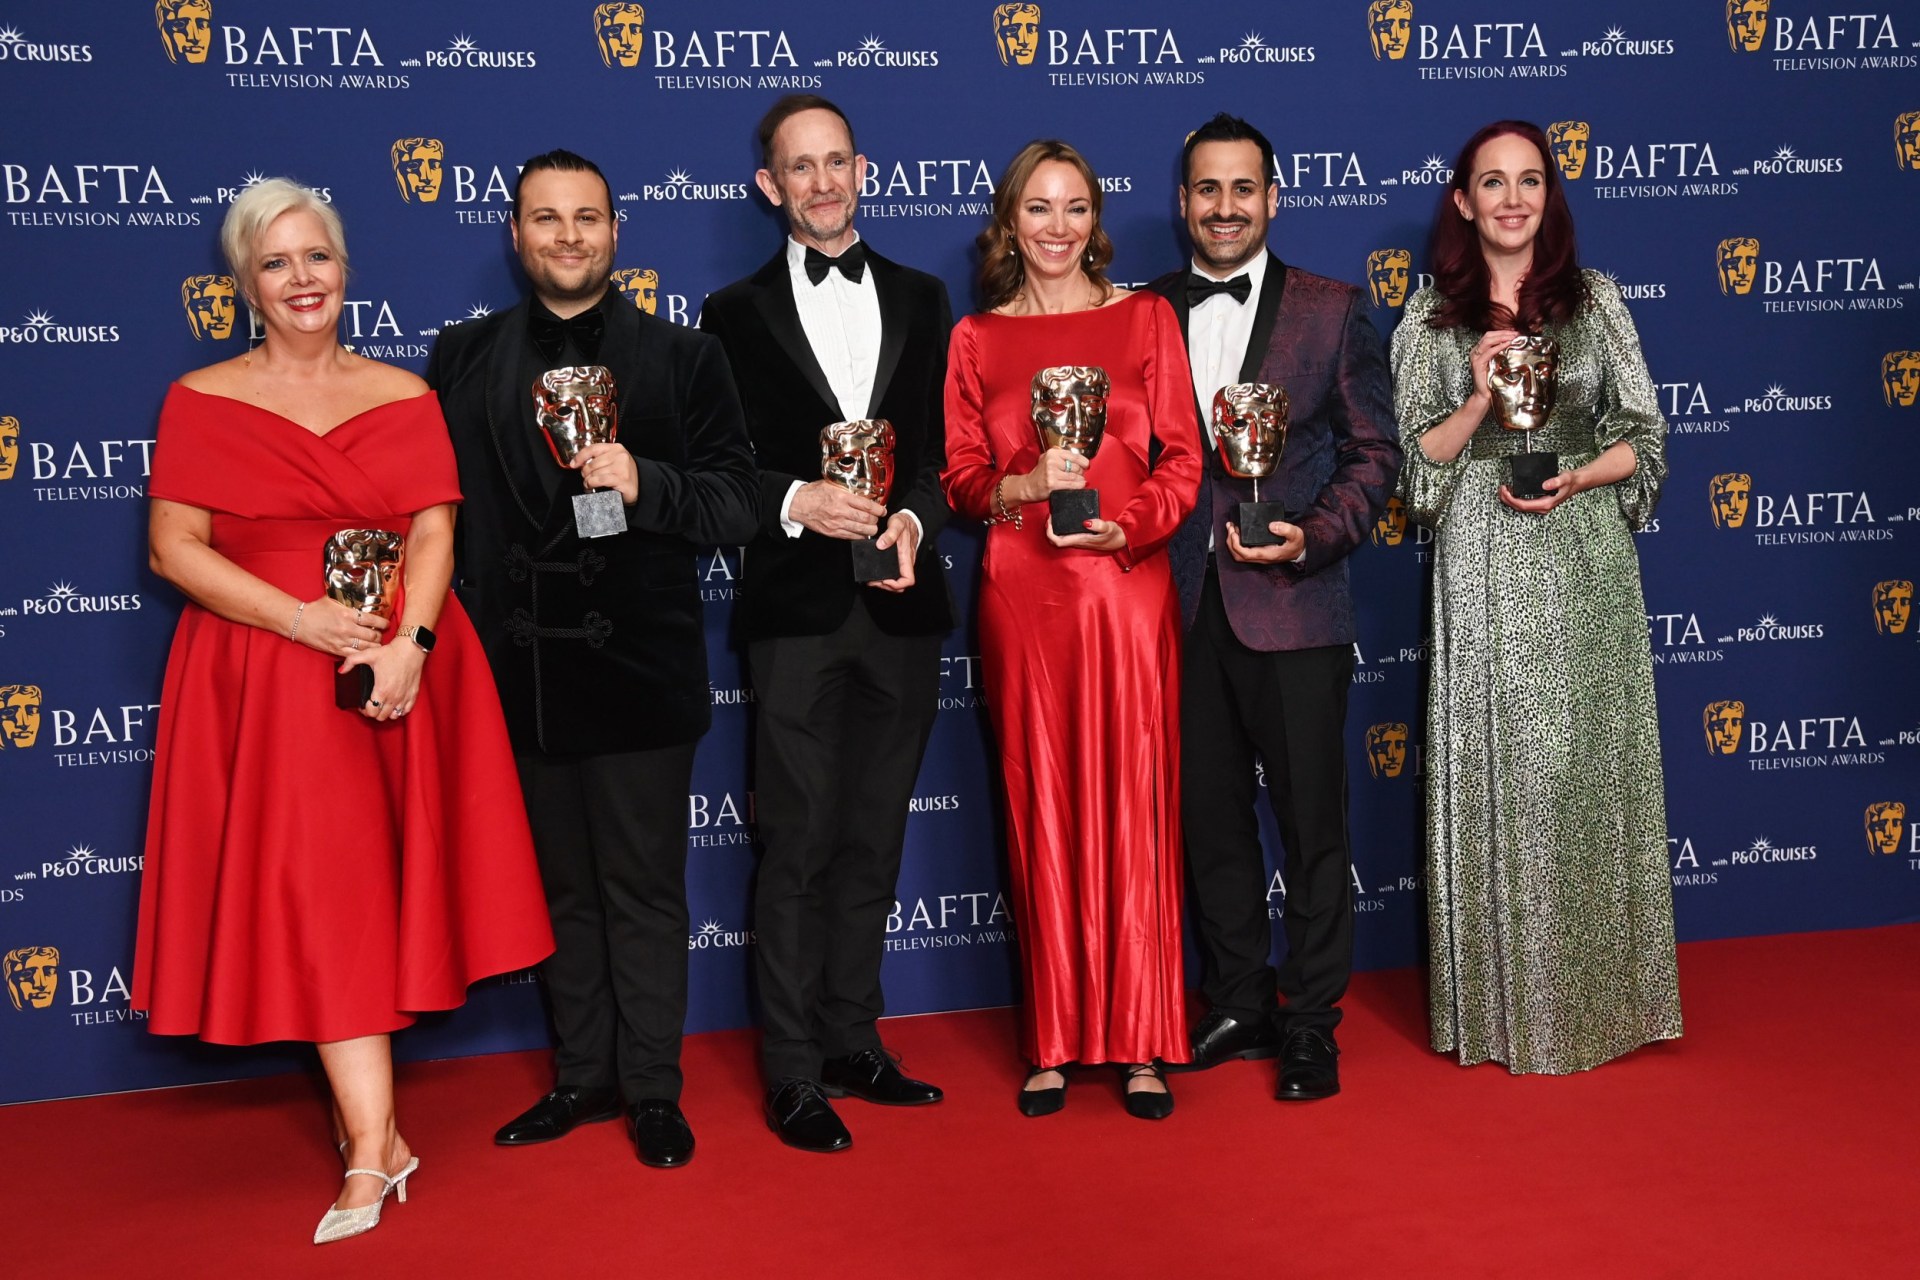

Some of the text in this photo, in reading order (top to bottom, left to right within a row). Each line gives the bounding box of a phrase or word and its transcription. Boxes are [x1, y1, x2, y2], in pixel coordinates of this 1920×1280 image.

[1774, 14, 1898, 51] BAFTA
[222, 26, 384, 66] BAFTA
[653, 31, 799, 67] BAFTA
[1048, 29, 1183, 65] BAFTA
[1419, 23, 1547, 59] BAFTA
[1583, 42, 1611, 56] P&O
[1616, 40, 1673, 55] CRUISES
[14, 44, 92, 61] CRUISES
[427, 51, 461, 67] P&O
[467, 52, 535, 67] CRUISES
[838, 52, 869, 66] P&O
[875, 52, 938, 66] CRUISES
[1221, 48, 1250, 62] P&O
[1255, 47, 1314, 62] CRUISES
[1773, 56, 1917, 70] TELEVISION AWARDS
[1049, 72, 1204, 85] TELEVISION AWARDS
[1419, 65, 1566, 79] TELEVISION AWARDS
[226, 74, 409, 88] TELEVISION AWARDS
[655, 76, 821, 88] TELEVISION AWARDS
[1595, 143, 1719, 179] BAFTA
[1754, 160, 1782, 174] P&O
[1786, 158, 1842, 173] CRUISES
[1272, 152, 1367, 188] AFTA
[1403, 170, 1431, 184] P&O
[3, 165, 173, 203] BAFTA
[644, 185, 676, 200] P&O
[682, 184, 747, 199] CRUISES
[1594, 183, 1738, 198] TELEVISION AWARDS
[217, 187, 240, 204] P&
[1329, 194, 1386, 206] AWARDS
[8, 212, 200, 225] TELEVISION AWARDS
[860, 204, 951, 217] TELEVISION
[1764, 258, 1885, 294] BAFTA
[1619, 284, 1667, 300] RUISES
[1763, 298, 1903, 312] TELEVISION AWARDS
[0, 326, 119, 342] P&O CRUISES
[420, 328, 439, 336] with
[361, 343, 430, 359] AWARDS
[1745, 398, 1772, 412] P&O
[1777, 396, 1831, 411] CRUISES
[1675, 421, 1729, 433] AWARDS
[29, 439, 157, 481] BAFT
[34, 486, 142, 501] TELEVISION
[1756, 492, 1874, 527] BAFTA
[1755, 529, 1893, 545] TELEVISION AWARDS
[24, 599, 61, 614] P&O
[67, 595, 140, 612] CRUISES
[1738, 628, 1765, 641] P&O
[1769, 625, 1823, 639] CRUISES
[1670, 650, 1723, 663] AWARDS
[1750, 717, 1866, 752] BAFTA
[1749, 753, 1884, 770] TELEVISION AWARDS
[908, 794, 960, 813] RUISES
[1732, 851, 1759, 864] P&O
[1763, 847, 1816, 862] CRUISES
[15, 856, 145, 880] with P&O CRUISE
[1672, 873, 1717, 886] WARDS
[884, 934, 970, 951] TELEVISION
